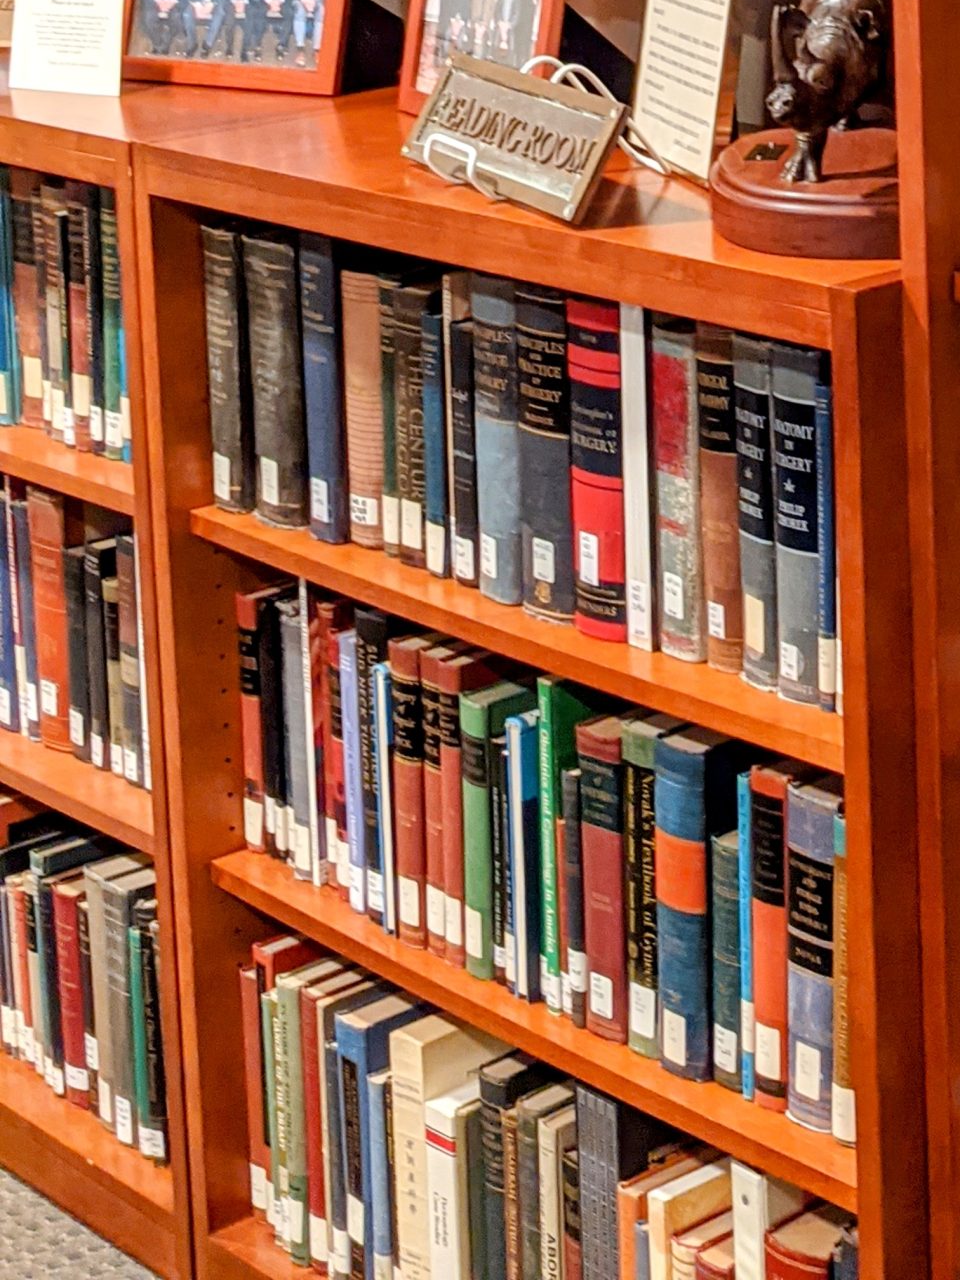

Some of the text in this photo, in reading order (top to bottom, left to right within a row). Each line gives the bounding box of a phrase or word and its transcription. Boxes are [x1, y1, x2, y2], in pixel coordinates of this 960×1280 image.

[428, 90, 598, 176] READING ROOM
[408, 354, 425, 500] THE CENTUR
[358, 678, 369, 719] NECK
[540, 729, 552, 789] Obstetrics
[541, 792, 553, 813] and
[641, 773, 655, 831] Novak's
[641, 837, 656, 905] Textbook
[545, 906, 556, 953] America
[642, 932, 656, 990] Gyneco
